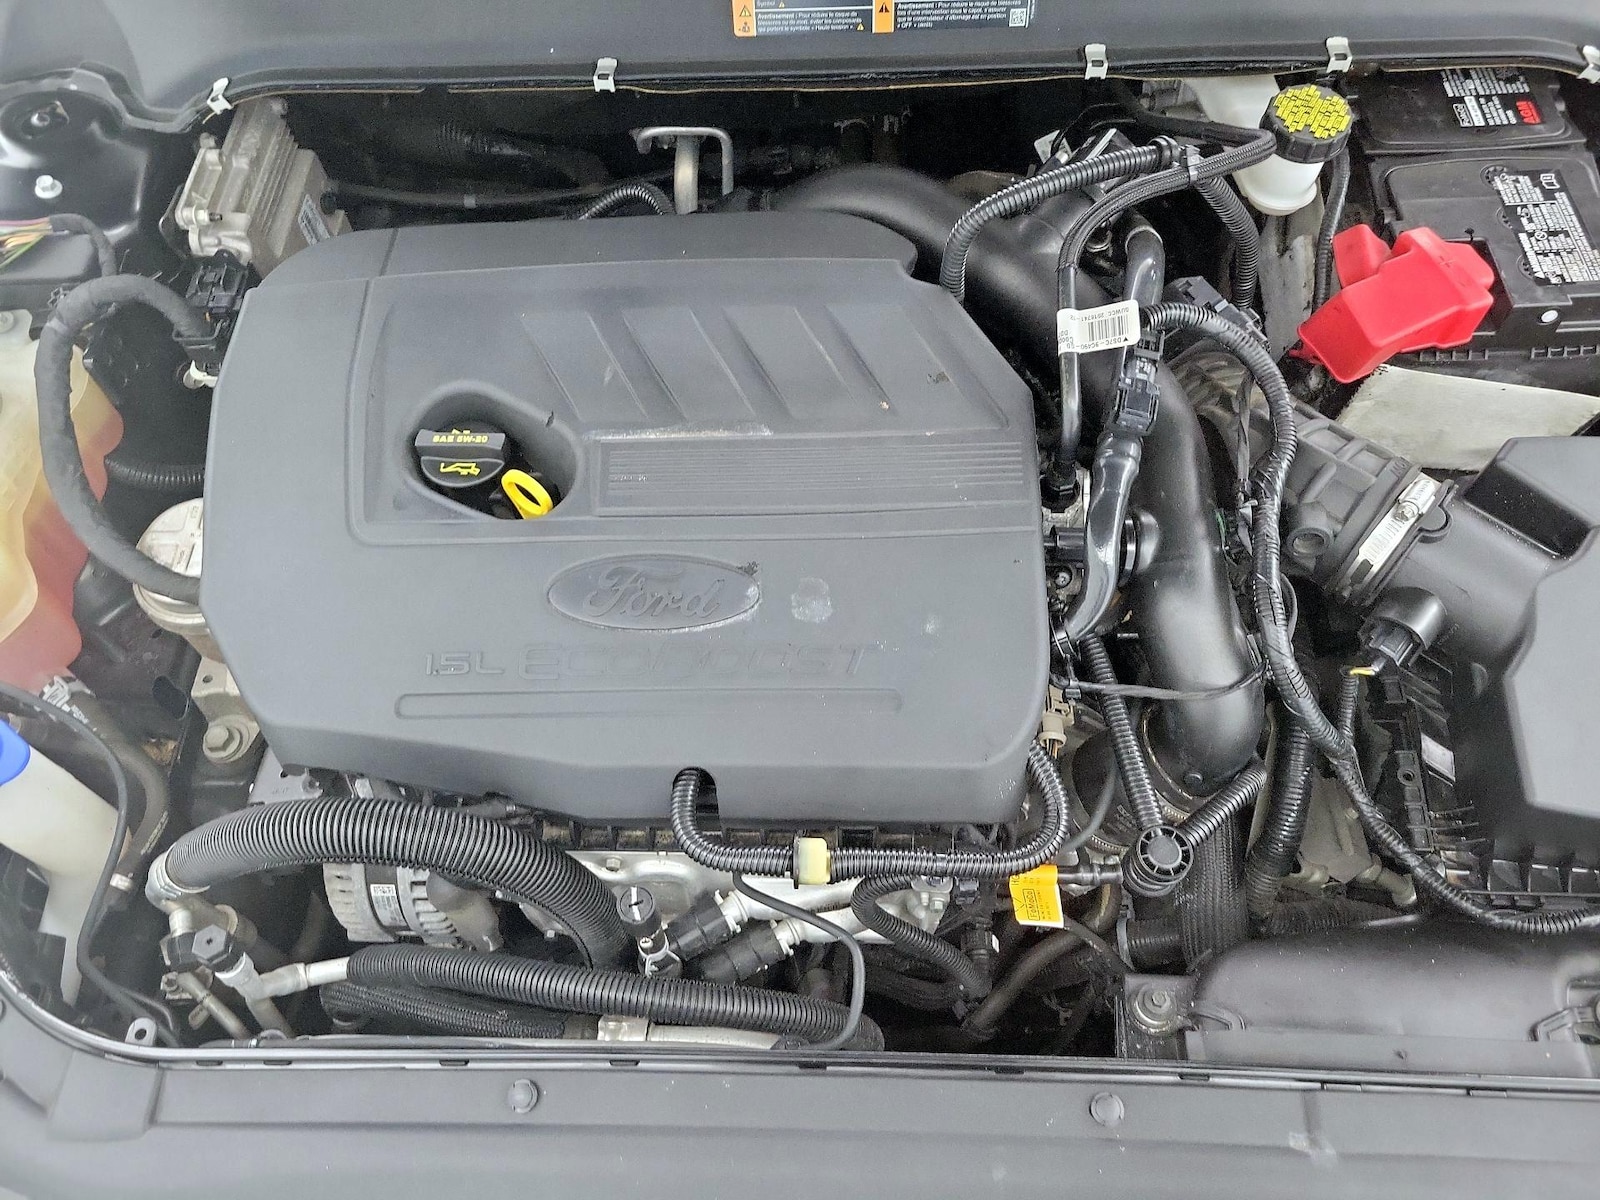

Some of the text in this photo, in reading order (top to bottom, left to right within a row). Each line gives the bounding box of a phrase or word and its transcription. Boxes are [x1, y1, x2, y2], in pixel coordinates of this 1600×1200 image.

[432, 435, 489, 443] SAE 5W-20
[584, 566, 722, 618] Ford
[425, 651, 505, 677] 1.5L
